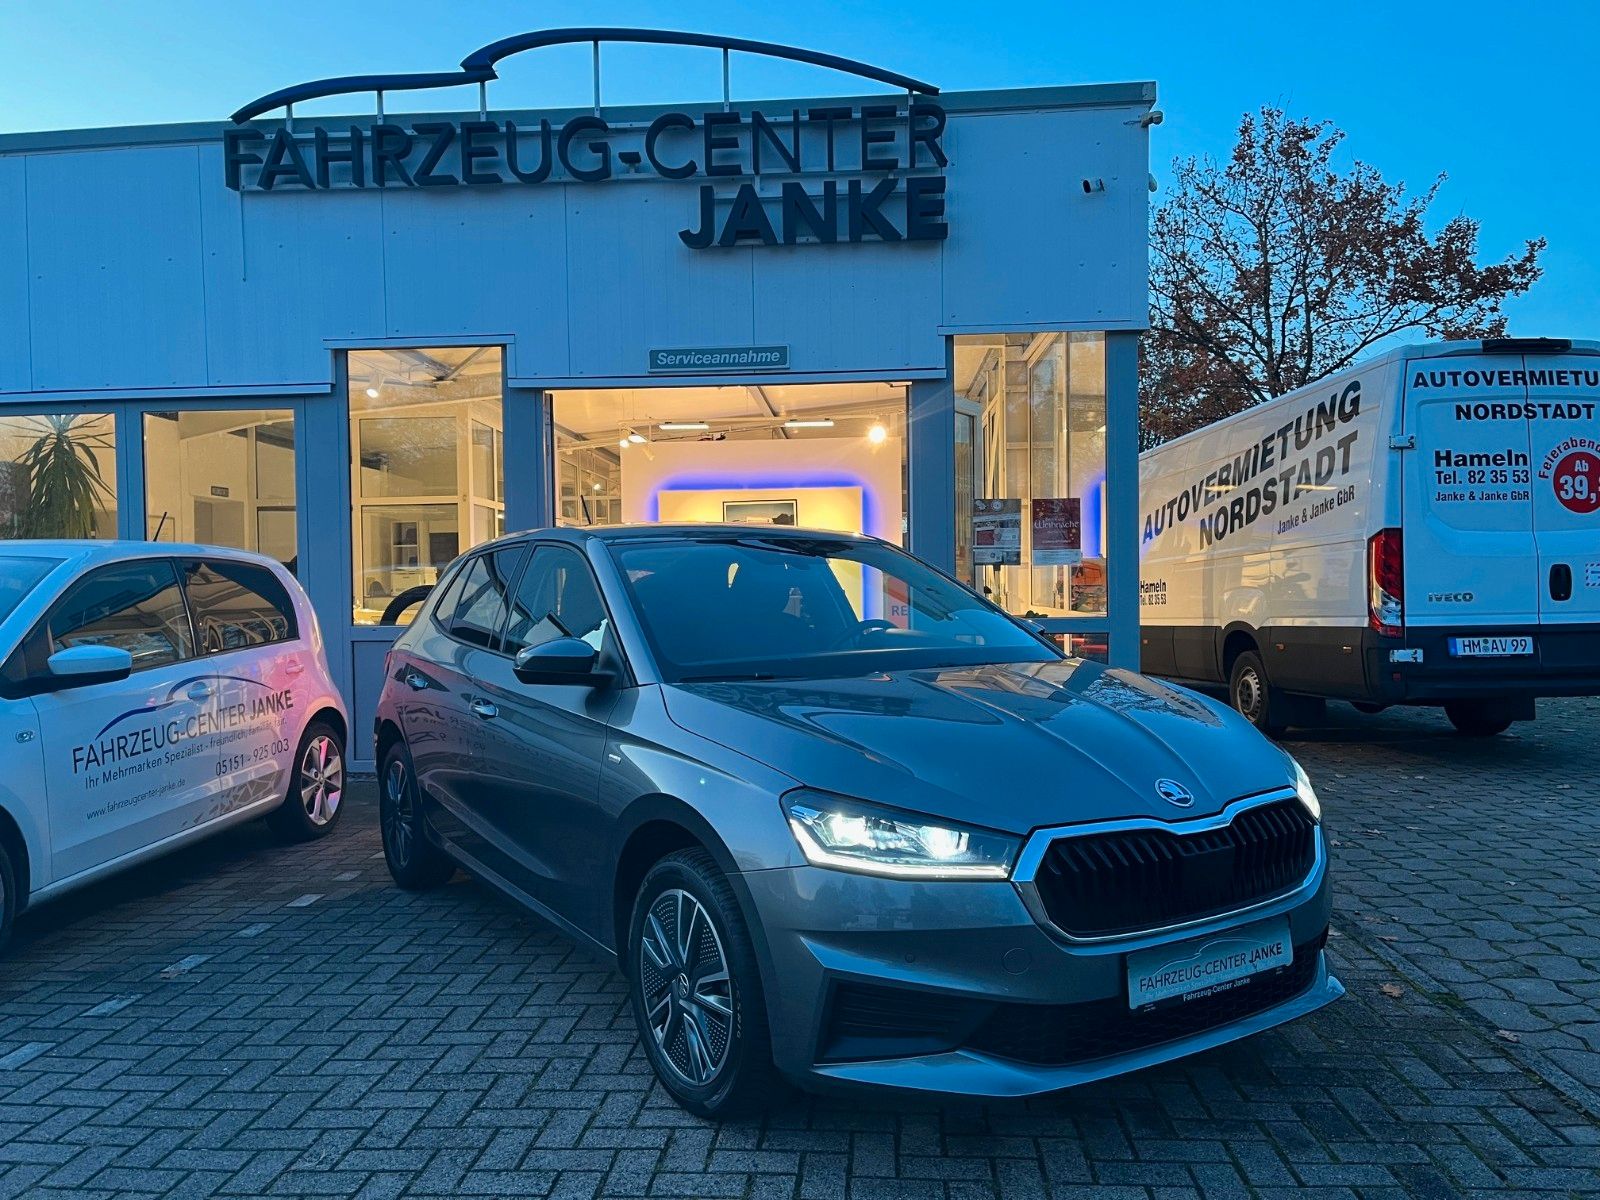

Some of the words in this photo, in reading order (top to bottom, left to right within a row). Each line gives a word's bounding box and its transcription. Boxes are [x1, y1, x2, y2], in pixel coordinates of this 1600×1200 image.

[222, 104, 948, 191] FAHRZEUG-CENTER
[678, 176, 949, 250] JANKE
[657, 351, 781, 365] Serviceannahme
[1455, 403, 1596, 420] NORDSTADT
[1142, 380, 1362, 544] AUTOVERMIETUNG
[1434, 450, 1528, 468] Hameln
[1574, 459, 1589, 472] Ab
[1200, 430, 1359, 550] NORDSTADT
[1435, 470, 1463, 485] Tel.
[1468, 470, 1486, 484] 82
[1490, 470, 1508, 484] 35
[1512, 470, 1530, 484] 53
[1277, 513, 1300, 535] Janke
[1301, 507, 1309, 524] &
[1309, 495, 1335, 520] Janke
[1336, 485, 1355, 508] GbR
[1435, 491, 1465, 502] Janke
[1468, 490, 1476, 501] &
[1479, 491, 1507, 501] Janke
[1510, 490, 1530, 501] GbR
[1140, 579, 1167, 593] Hameln
[1428, 592, 1474, 602] IVECO
[1463, 639, 1481, 653] HM
[1490, 639, 1508, 653] AV
[1511, 638, 1527, 653] 99
[72, 703, 246, 774] FAHRZEUG-CENTER
[249, 689, 294, 721] JANKE
[85, 776, 99, 790] Ihr
[102, 757, 162, 784] Mehrmarken
[164, 743, 204, 765] Spezialist
[216, 754, 245, 776] 05151
[253, 744, 269, 762] 925
[271, 738, 290, 756] 003
[1139, 952, 1247, 992] FAHRZEUG-CENTER
[1249, 943, 1282, 964] JANKE
